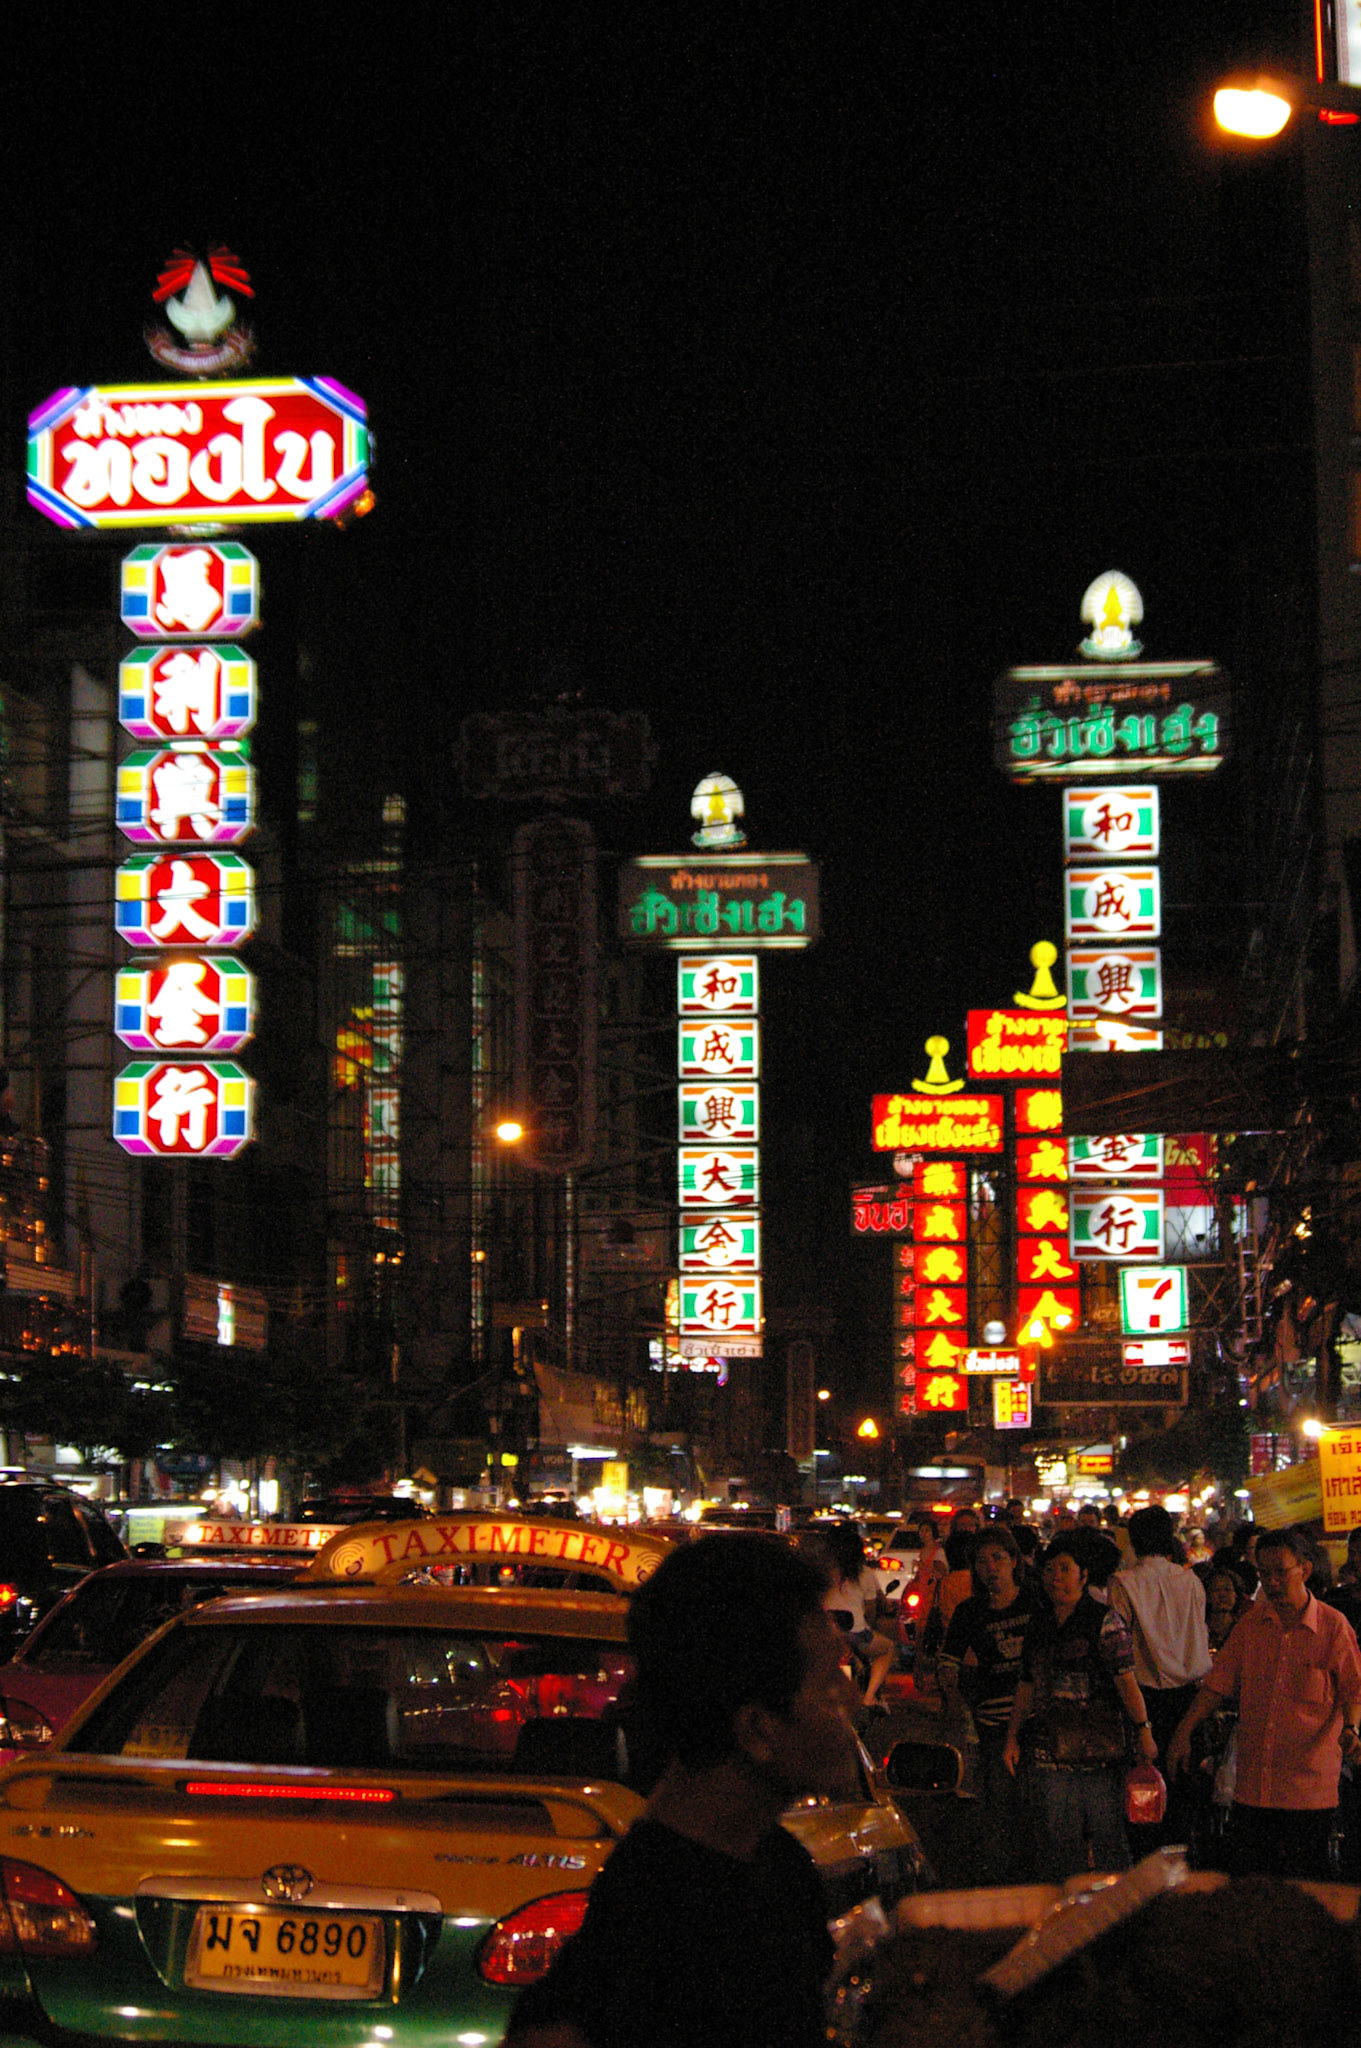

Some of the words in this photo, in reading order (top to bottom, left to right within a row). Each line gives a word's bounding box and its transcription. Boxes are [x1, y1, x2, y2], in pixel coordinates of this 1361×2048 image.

[700, 968, 738, 1325] 和成興大金行
[373, 1524, 631, 1576] TAXI-METER
[277, 1919, 367, 1958] 6890
